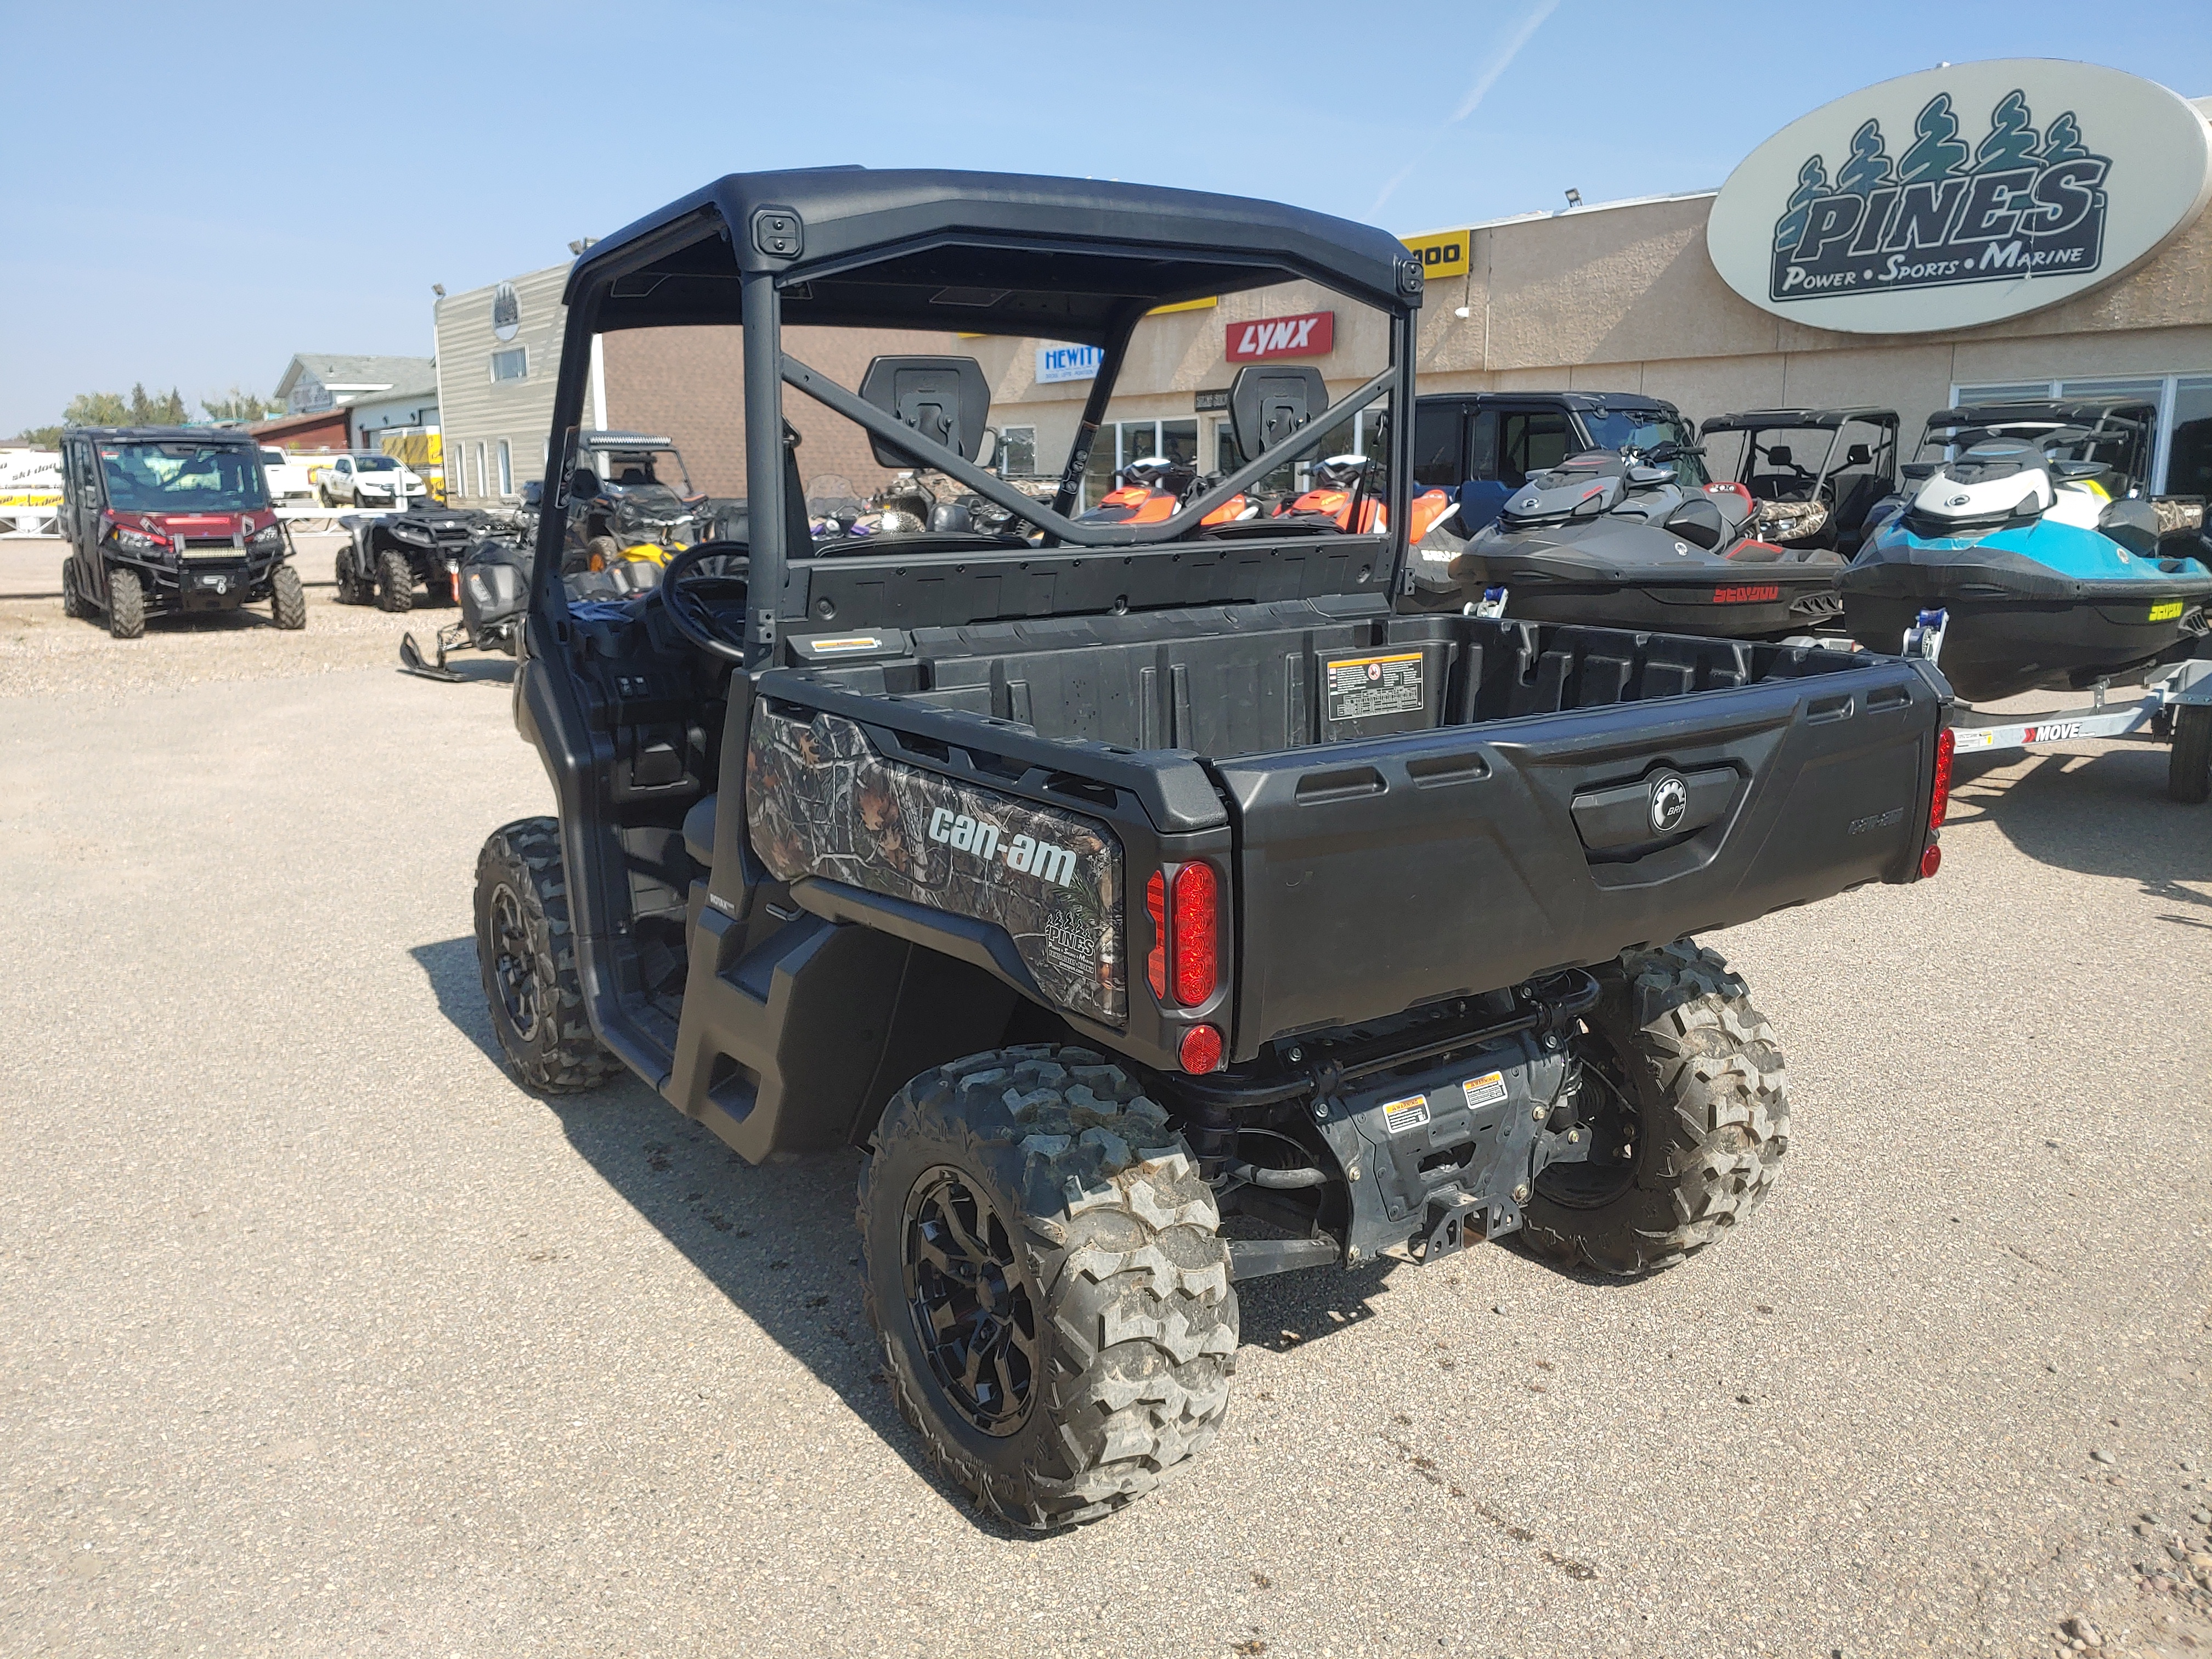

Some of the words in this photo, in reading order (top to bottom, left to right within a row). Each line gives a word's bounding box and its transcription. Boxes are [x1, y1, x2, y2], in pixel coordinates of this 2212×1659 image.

[1791, 158, 2107, 263] PINES
[1237, 318, 1318, 356] LYNX
[2035, 723, 2083, 742] MOVE
[1667, 804, 1684, 816] BRP
[928, 806, 1077, 888] can-am
[1048, 925, 1094, 956] PINES
[1475, 1076, 1496, 1087] WARNING
[1396, 1099, 1419, 1110] WARNING
